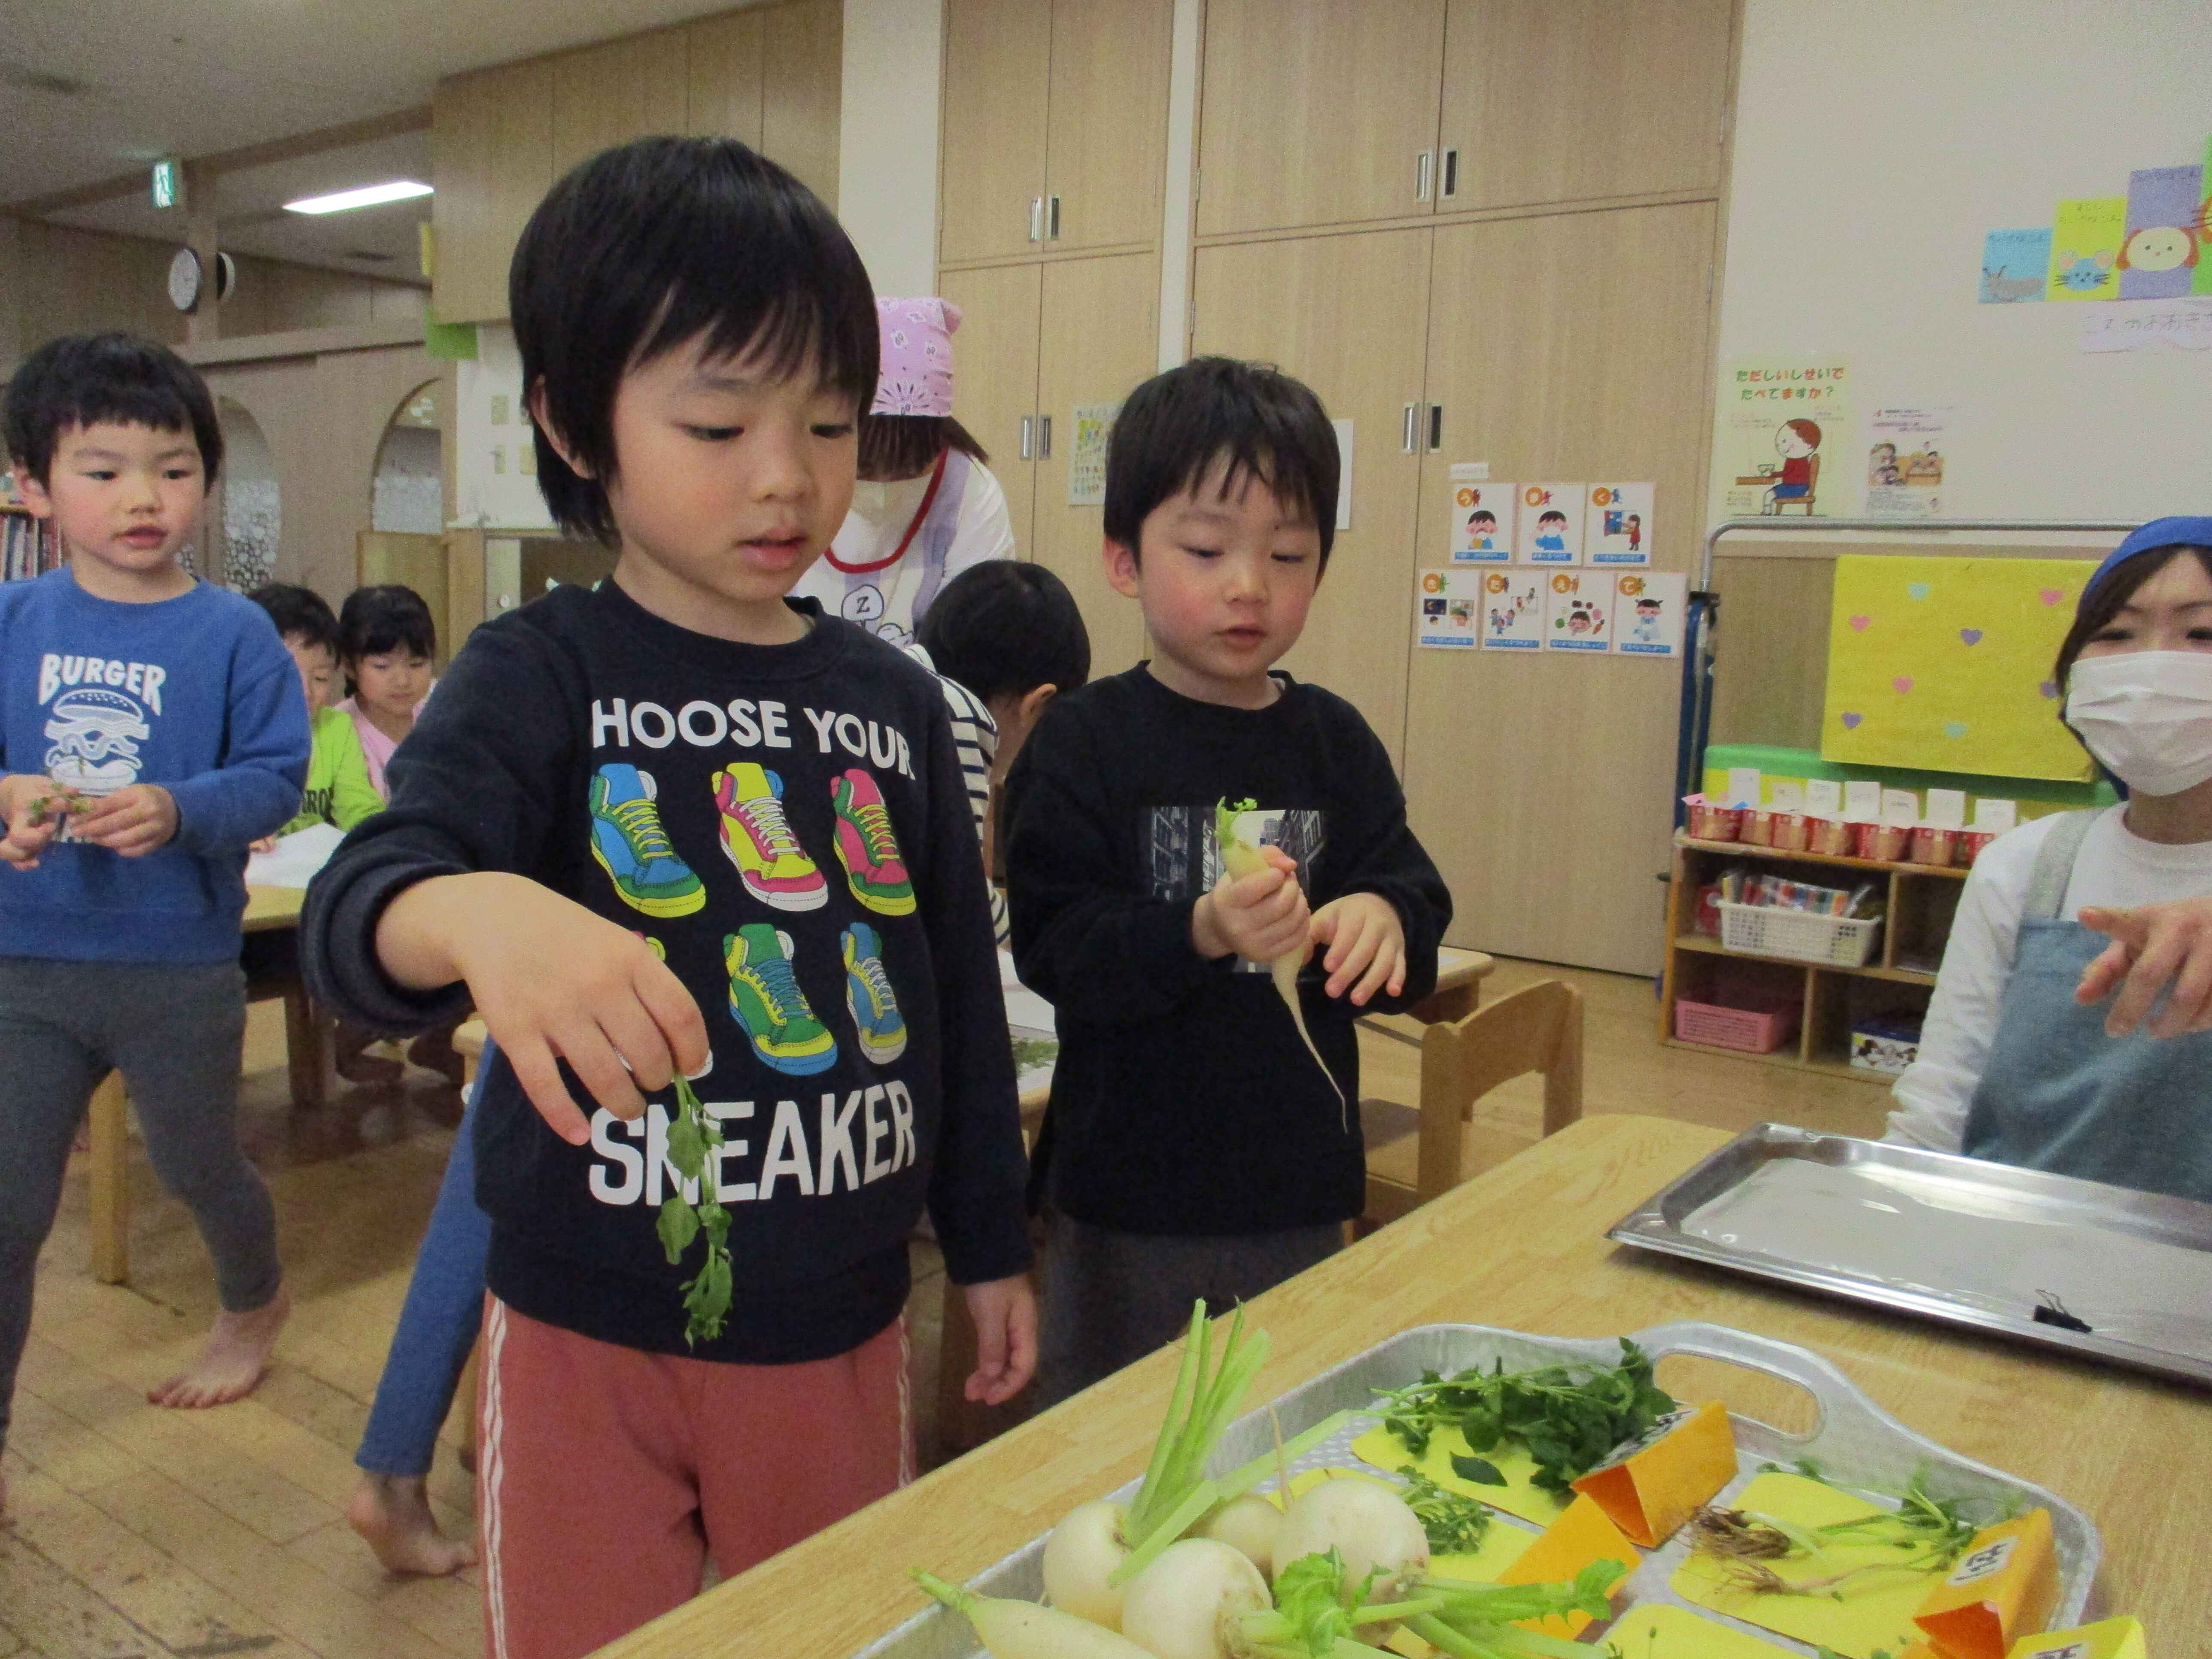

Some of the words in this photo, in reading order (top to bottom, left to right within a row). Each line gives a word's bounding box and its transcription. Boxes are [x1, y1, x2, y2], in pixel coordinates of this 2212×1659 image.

[1737, 368, 1844, 382] ただしいしせいで
[38, 653, 166, 716] BURGER
[592, 698, 791, 748] HOOSE
[804, 708, 915, 780] YOUR
[589, 1080, 916, 1206] SNEAKER
